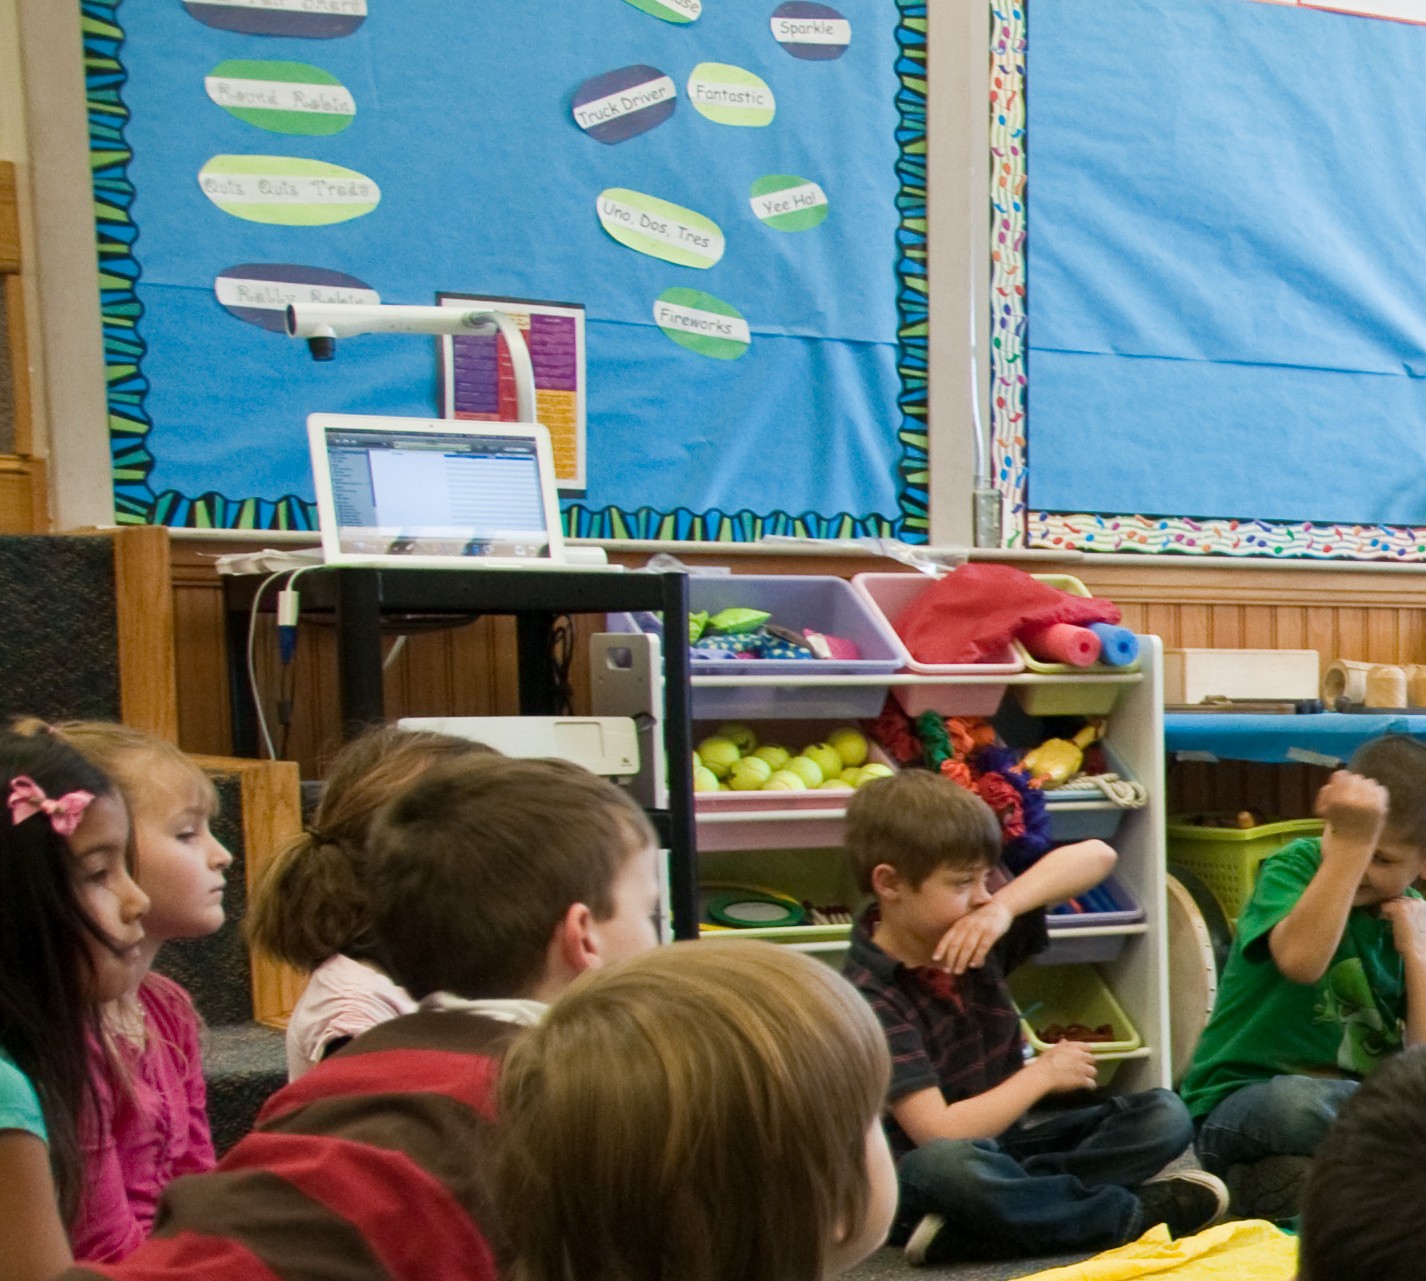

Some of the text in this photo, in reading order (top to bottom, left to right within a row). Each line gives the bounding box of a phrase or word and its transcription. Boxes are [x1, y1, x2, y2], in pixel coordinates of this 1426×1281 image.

[780, 21, 834, 37] Sparkle
[217, 82, 350, 113] Round Robin
[577, 84, 667, 127] Truck Driver
[695, 84, 764, 106] Fantastic
[310, 179, 370, 196] Trade
[763, 192, 816, 214] Yee Ha!
[602, 201, 711, 248] Uno, Dos, Tres
[659, 307, 732, 335] Fireworks
